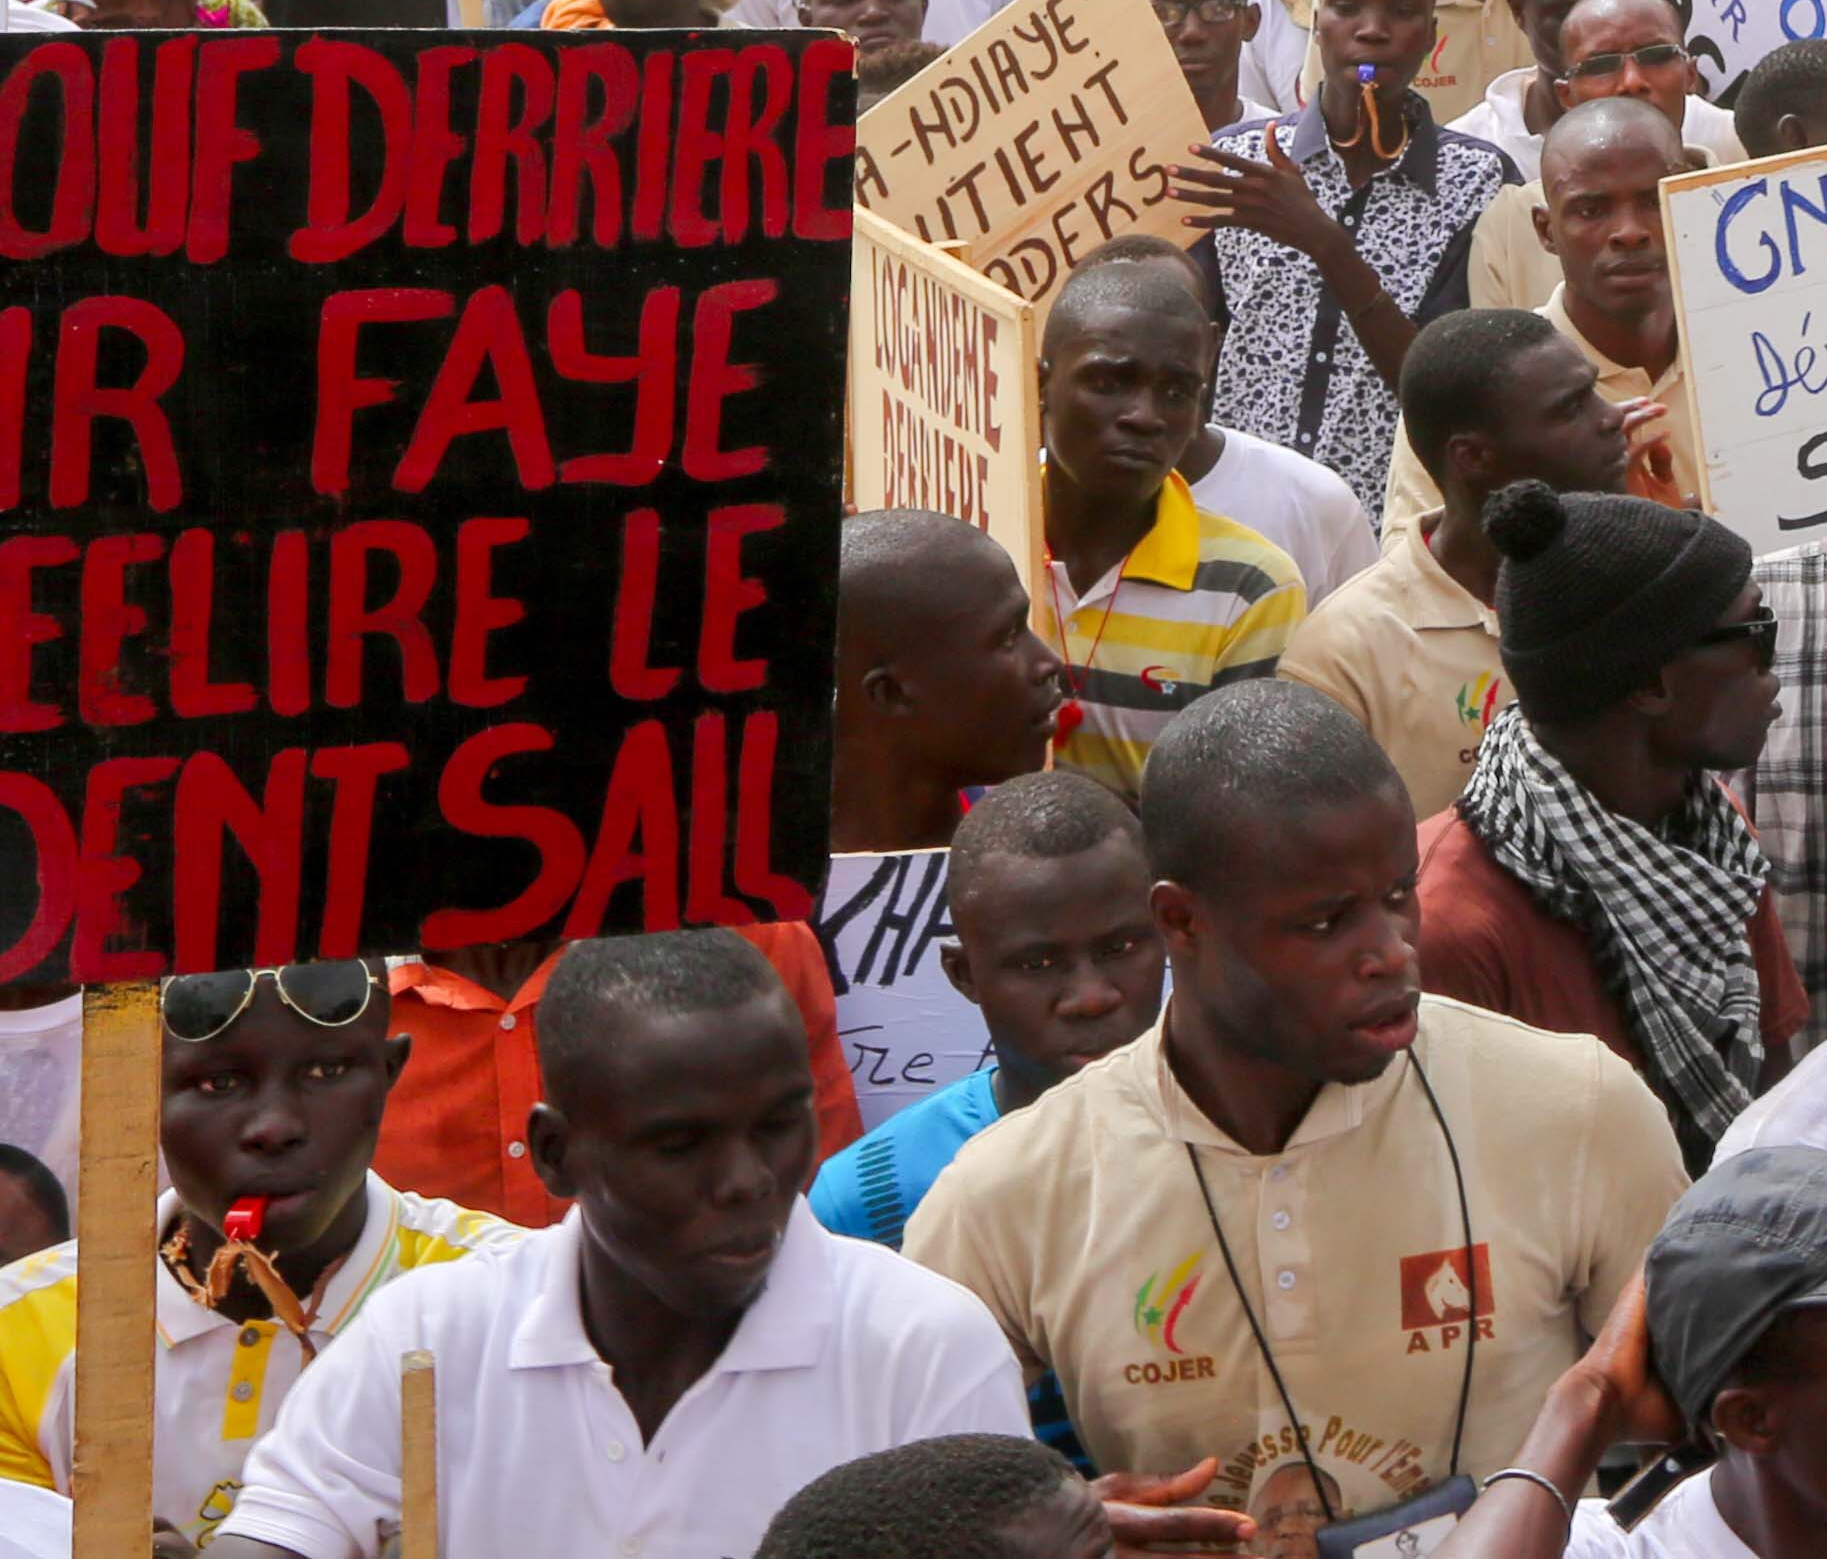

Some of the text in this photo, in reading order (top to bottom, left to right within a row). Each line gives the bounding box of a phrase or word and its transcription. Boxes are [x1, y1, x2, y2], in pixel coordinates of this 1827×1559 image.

[288, 31, 857, 263] DERRIERE
[309, 279, 781, 496] FAYE
[607, 504, 787, 701] LE
[419, 710, 814, 950] SALL
[1123, 1355, 1218, 1386] COJER
[1316, 1414, 1387, 1466] Pour
